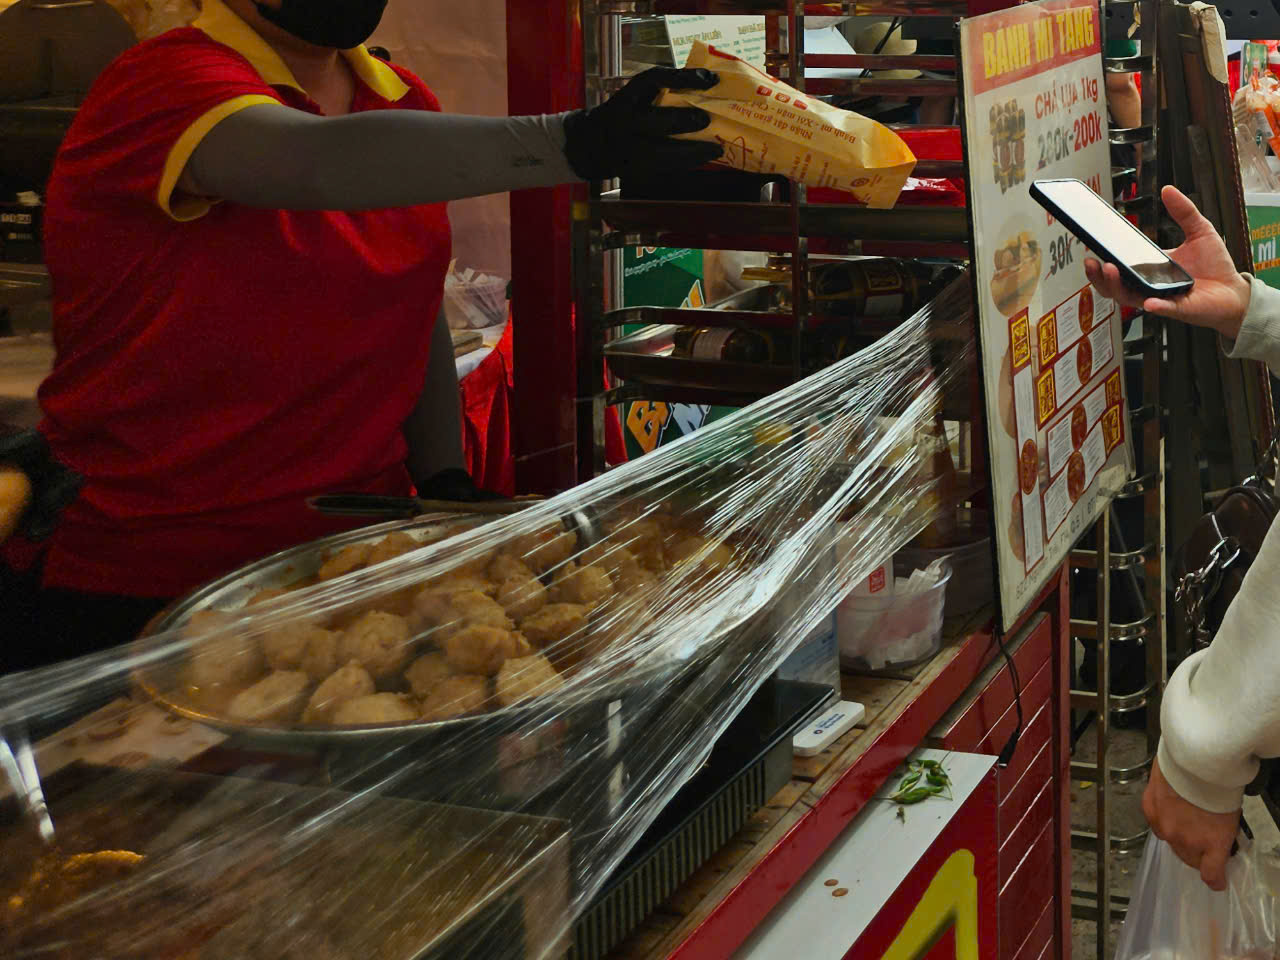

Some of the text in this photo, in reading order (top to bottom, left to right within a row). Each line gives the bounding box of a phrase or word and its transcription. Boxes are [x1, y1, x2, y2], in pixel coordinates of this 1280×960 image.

[983, 21, 1032, 81] BÁNH
[1081, 76, 1098, 103] 1kg
[1049, 232, 1073, 276] 30k
